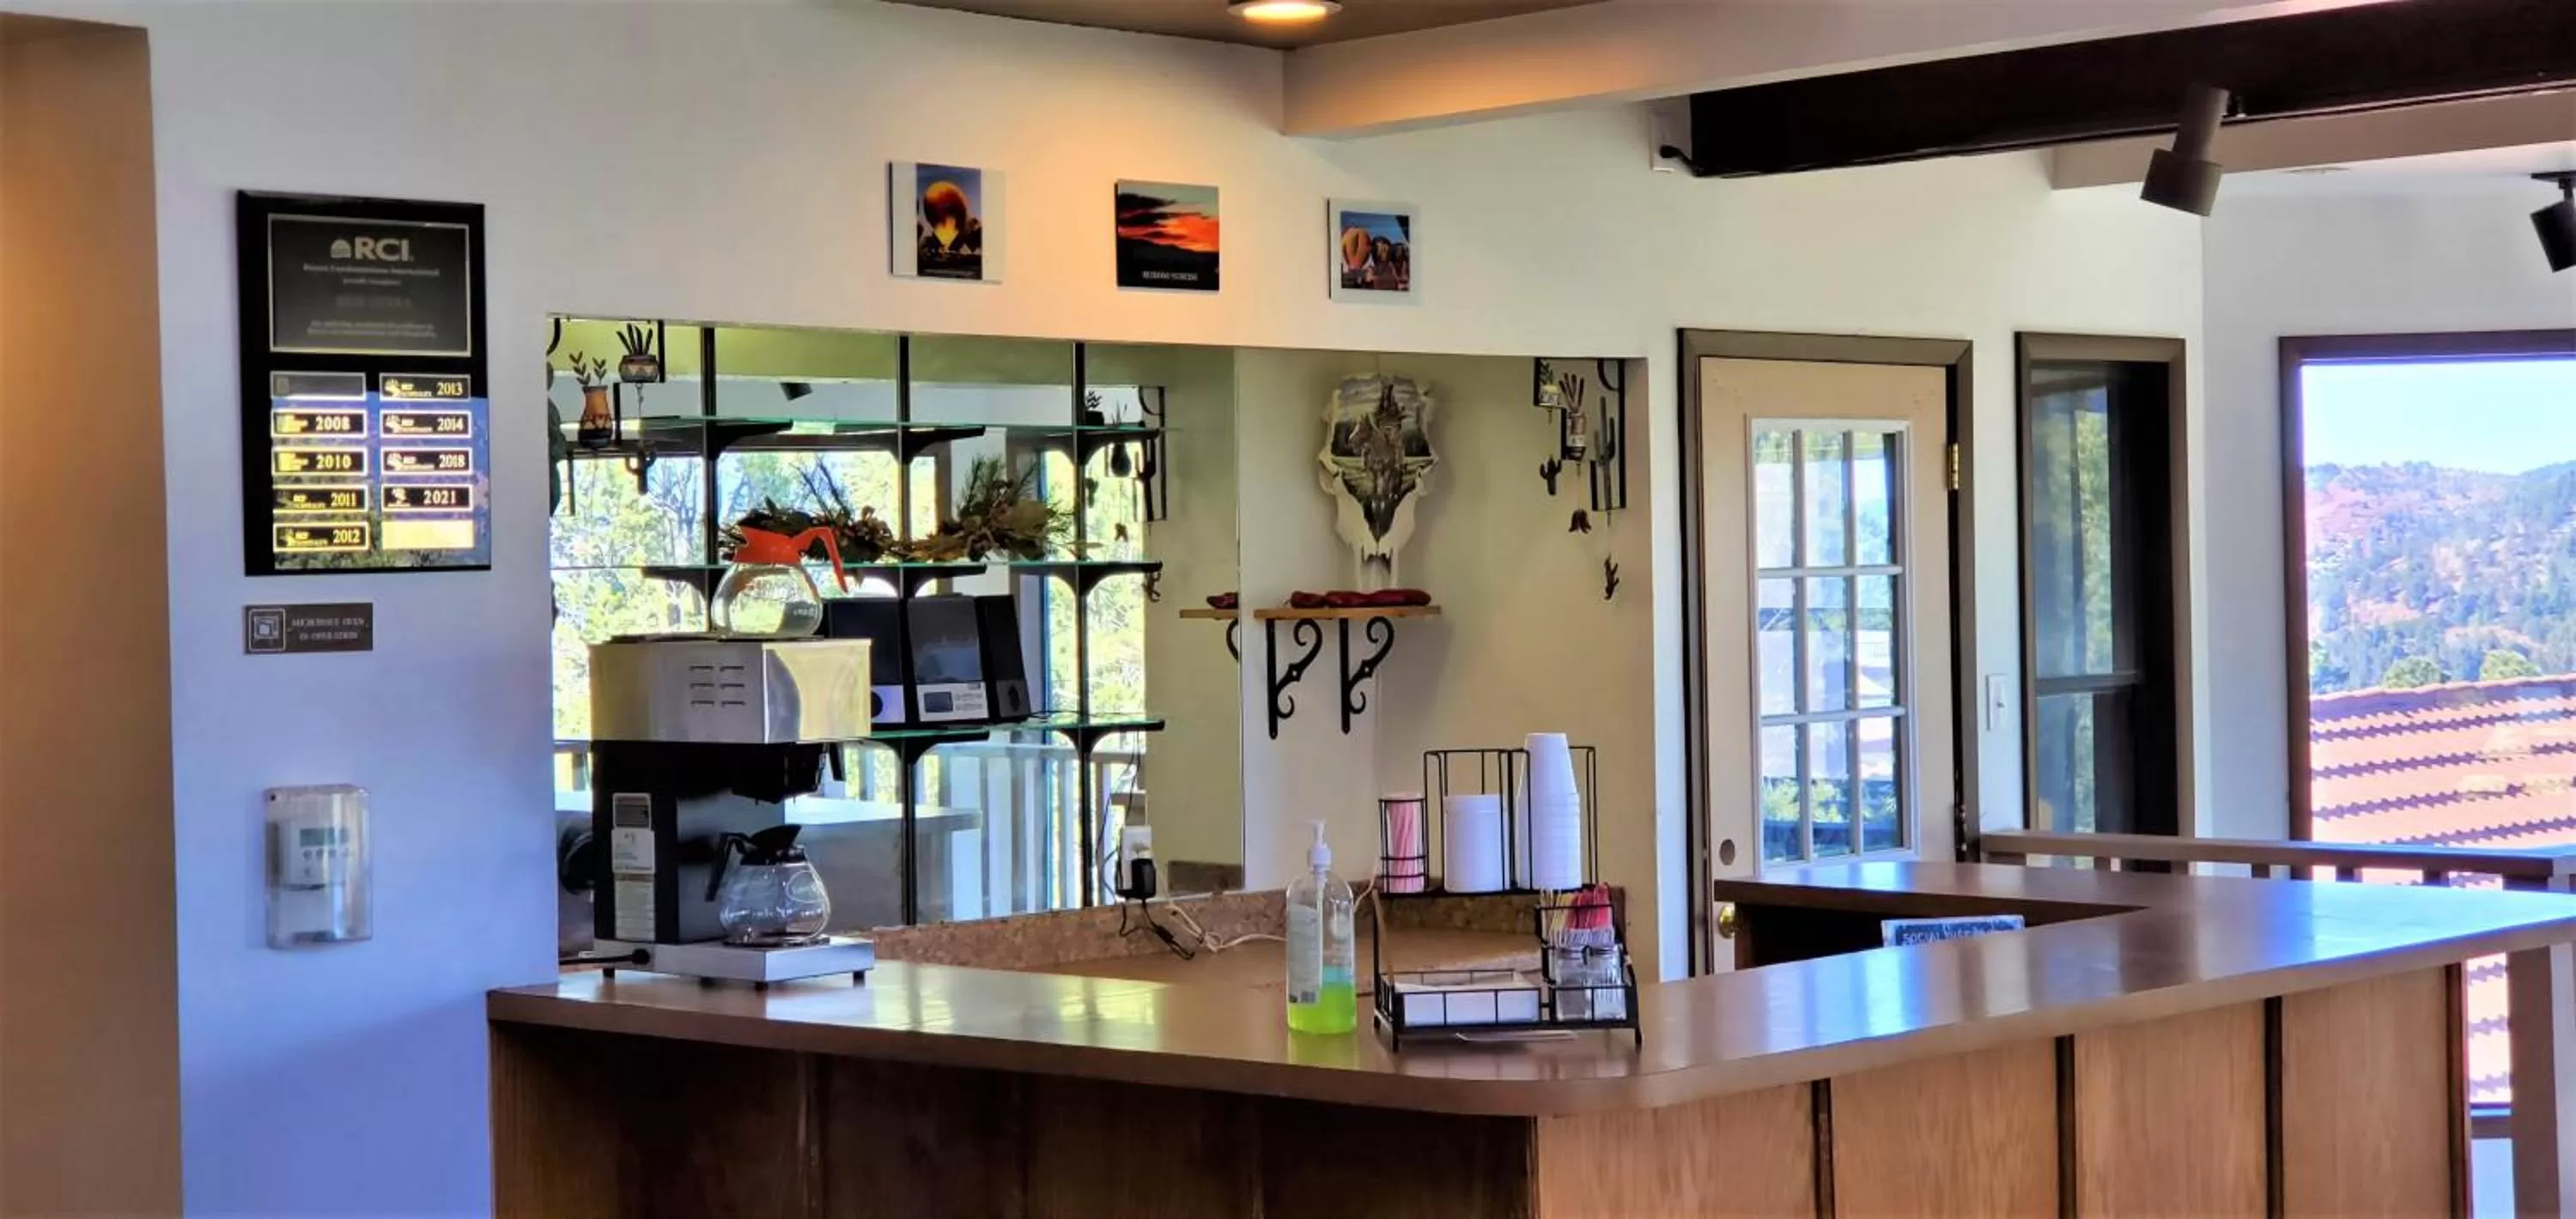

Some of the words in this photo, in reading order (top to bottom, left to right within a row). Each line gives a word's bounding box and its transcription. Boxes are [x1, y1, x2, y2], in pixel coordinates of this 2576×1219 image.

[354, 236, 410, 262] RCI
[436, 382, 463, 396] 2013
[315, 415, 350, 431] 2008
[436, 417, 464, 432] 2014
[316, 455, 352, 470] 2010
[439, 454, 465, 469] 2018
[331, 492, 357, 507] 2011
[423, 490, 456, 505] 2021
[332, 529, 360, 543] 2012
